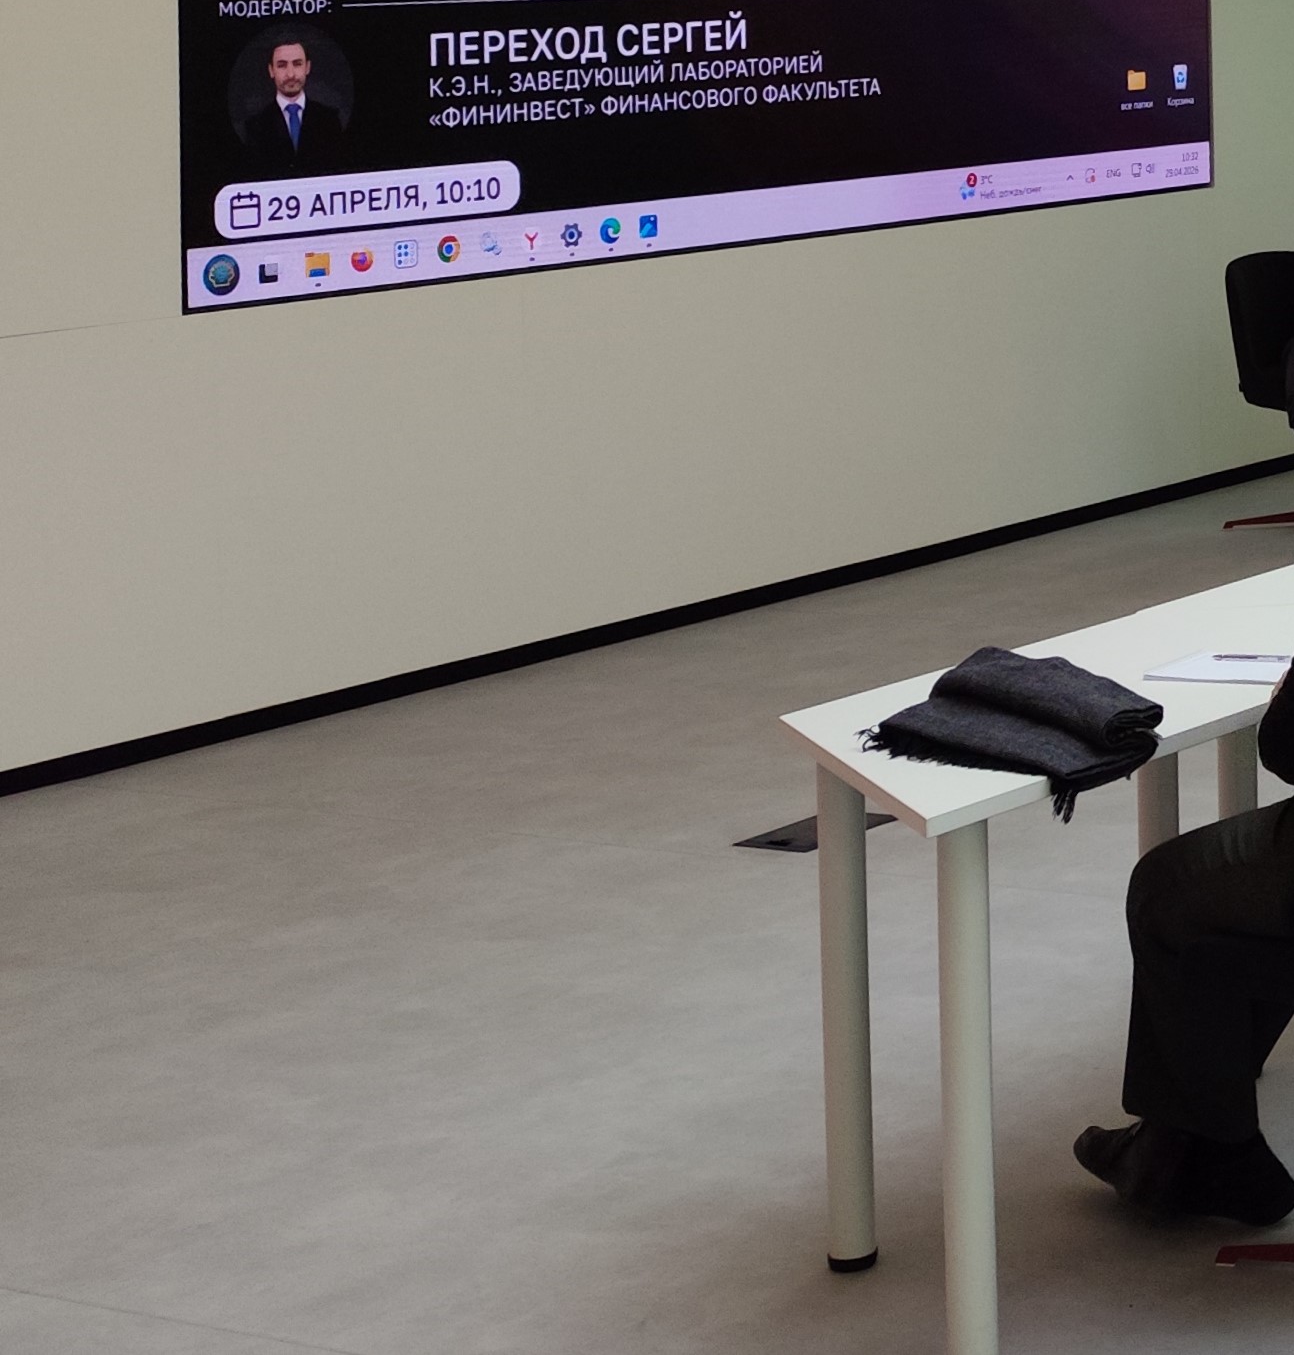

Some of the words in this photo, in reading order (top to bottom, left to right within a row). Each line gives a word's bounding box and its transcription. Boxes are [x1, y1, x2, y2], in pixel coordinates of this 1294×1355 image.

[430, 25, 608, 67] ПЕРЕХОД
[616, 10, 747, 57] СЕРГЕЙ
[429, 74, 502, 98] К.Э.Н.,
[509, 59, 664, 93] ЗАВЕДУЮЩИЙ
[669, 50, 823, 82] ЛАБОРАТОРИЕЙ
[429, 97, 596, 128] «ФИНИНВЕСТ»
[600, 86, 758, 116] ФИНАНСОВОГО
[762, 77, 882, 104] ФАКУЛЬТЕТА
[1167, 97, 1194, 107] Корзина
[1106, 169, 1121, 178] ENG
[1182, 152, 1198, 162] 10:32
[267, 195, 301, 222] 29
[309, 184, 427, 218] АПРЕЛЯ,
[436, 176, 501, 205] 10:10
